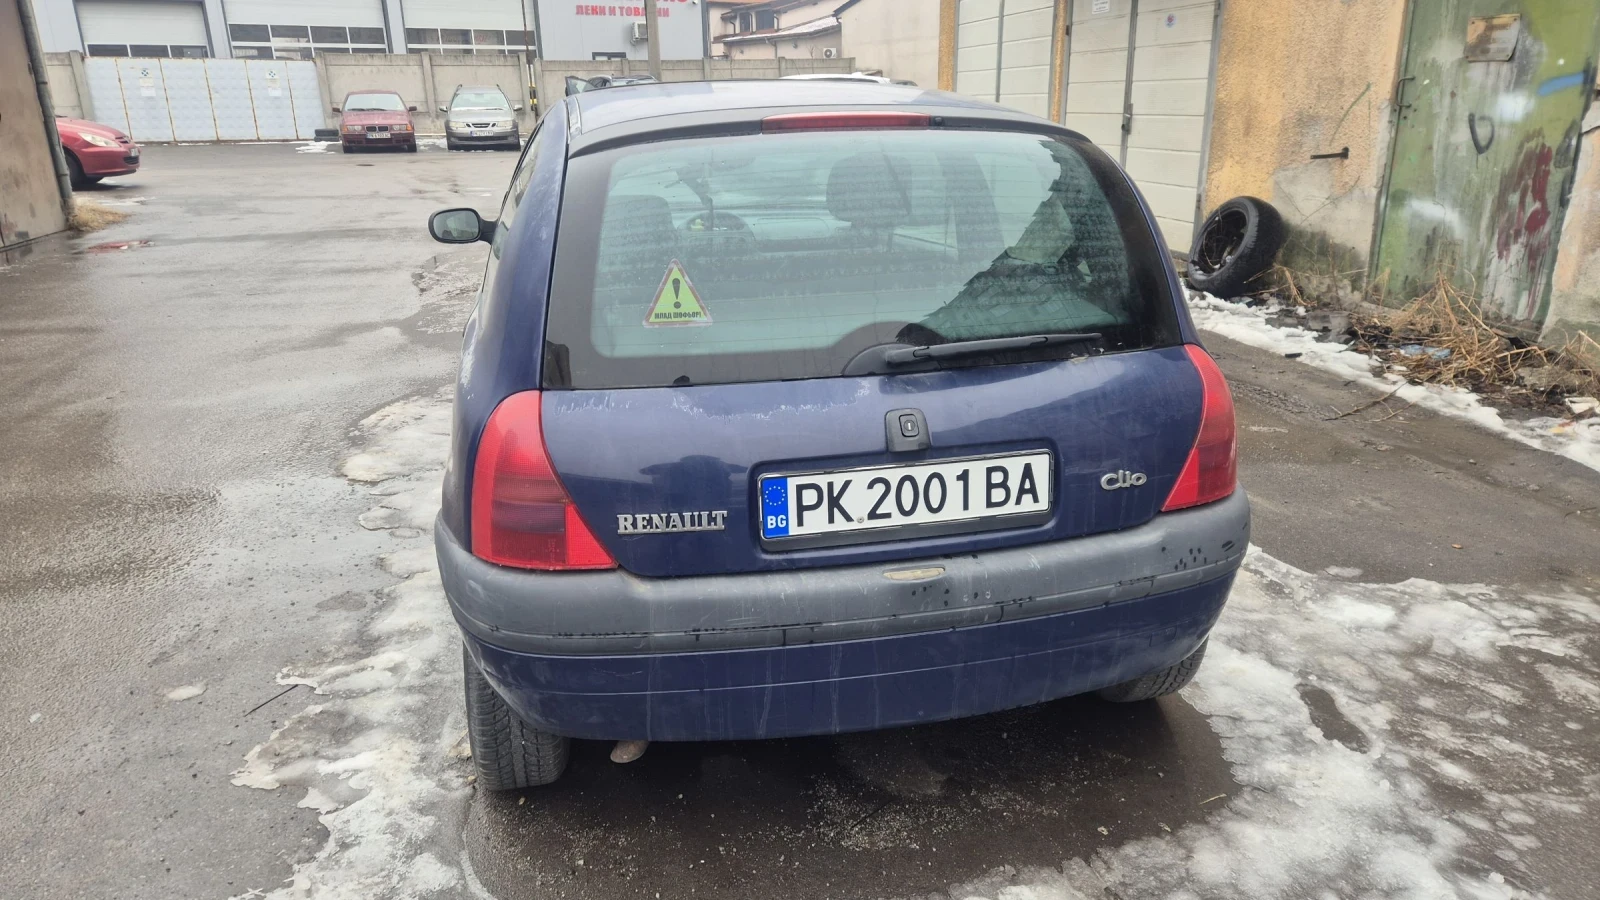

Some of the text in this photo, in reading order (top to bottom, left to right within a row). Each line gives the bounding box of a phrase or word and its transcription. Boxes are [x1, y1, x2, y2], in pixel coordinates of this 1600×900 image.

[575, 5, 670, 17] ЛЕКИ И ТОВАНИ
[1100, 469, 1147, 490] Clio
[767, 462, 1040, 529] BG PK 2001 BA
[617, 510, 728, 535] RENAULT
